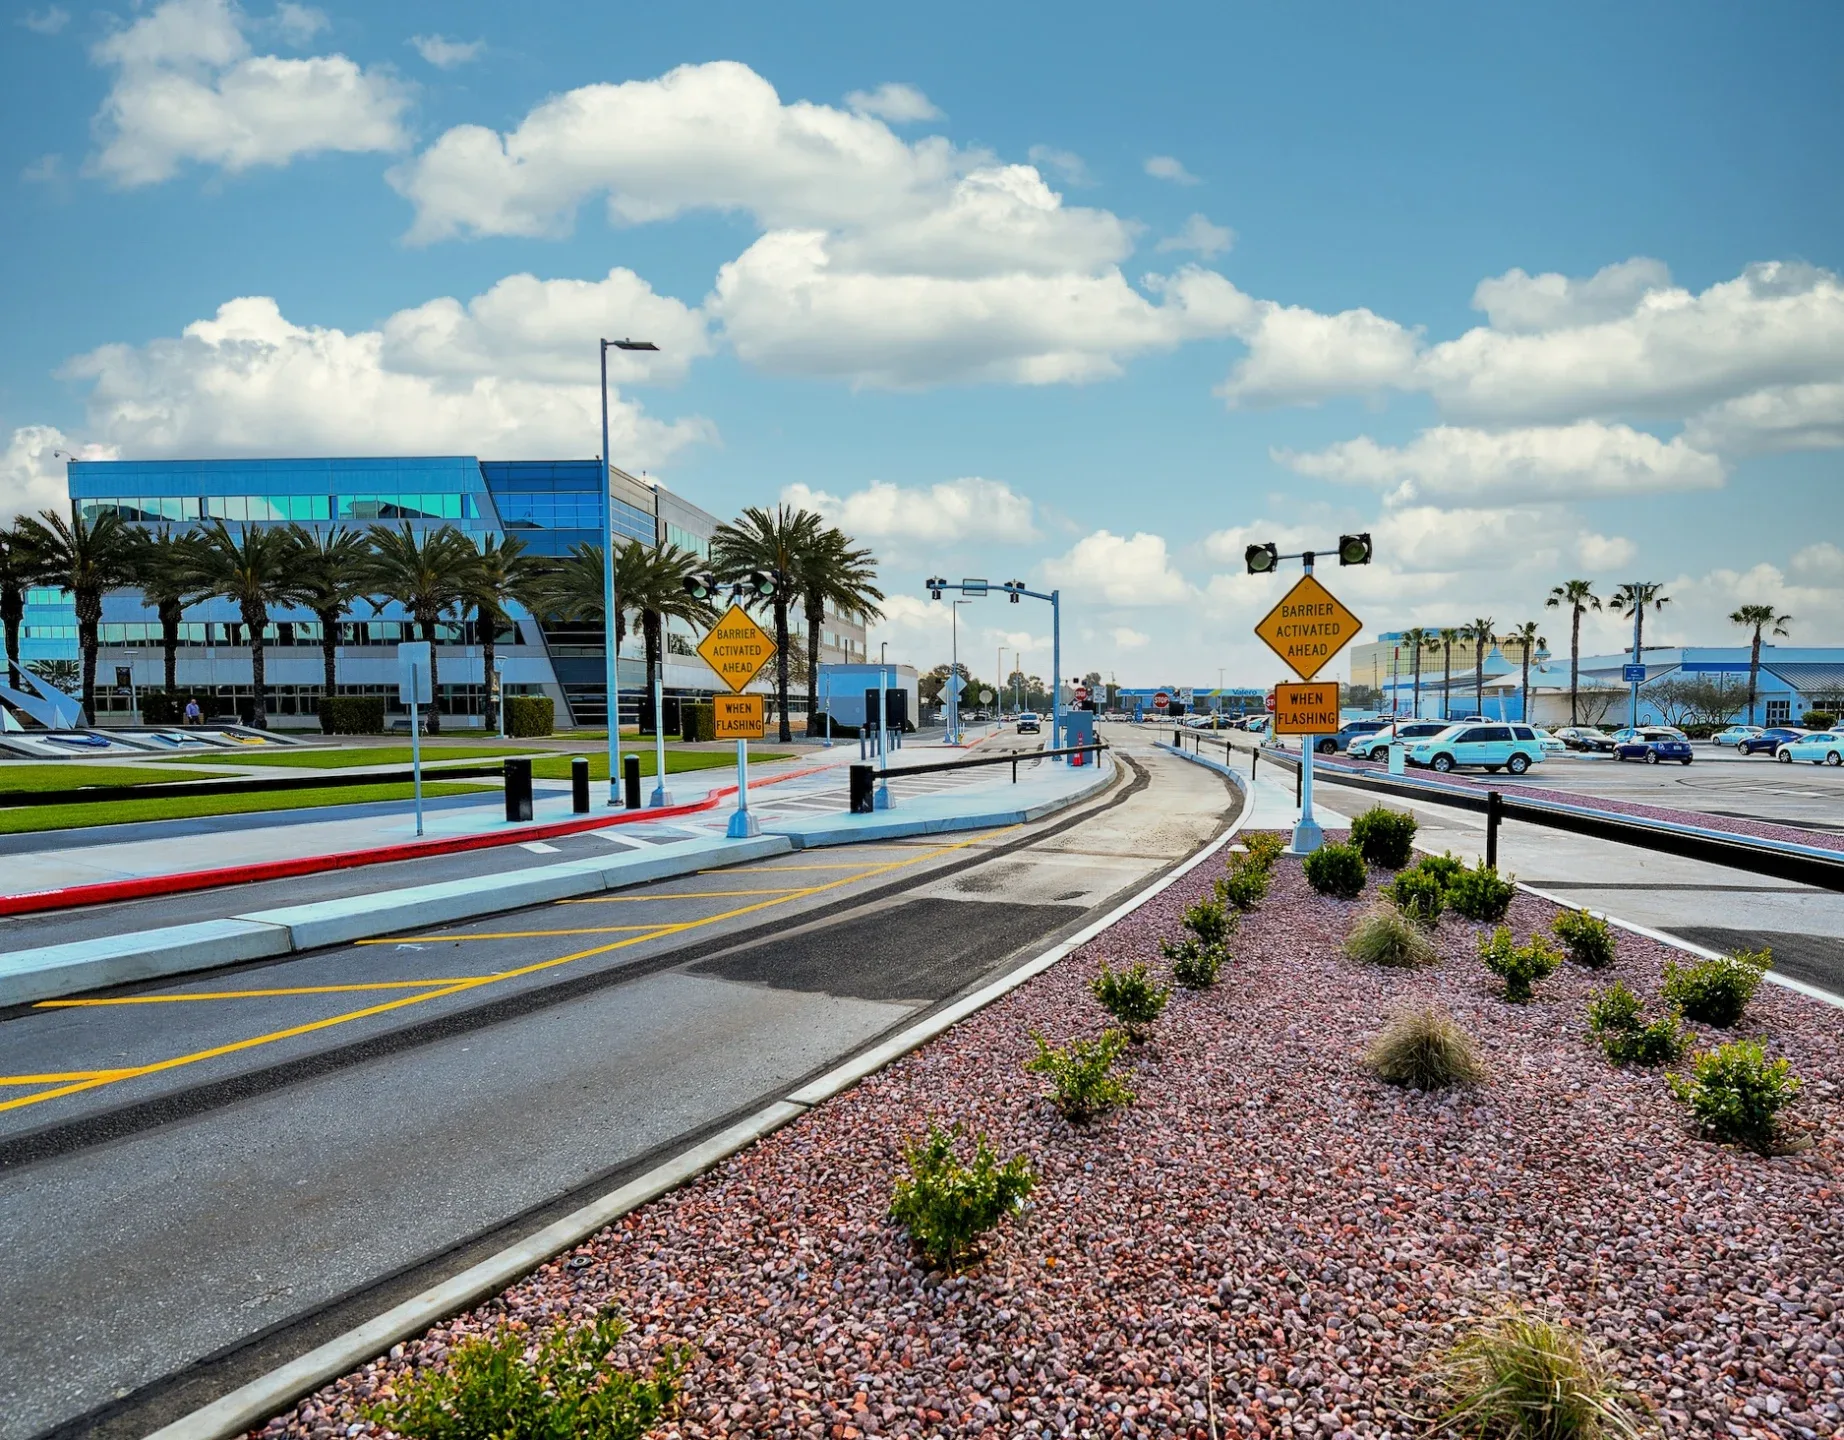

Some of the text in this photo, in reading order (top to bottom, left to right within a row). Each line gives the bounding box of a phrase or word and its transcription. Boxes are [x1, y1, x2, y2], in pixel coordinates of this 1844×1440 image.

[1282, 603, 1333, 617] BARRIER
[717, 628, 756, 639] BARRIER
[1276, 623, 1340, 637] ACTIVATED
[713, 645, 761, 656] ACTIVATED
[1287, 644, 1328, 656] AHEAD
[722, 662, 752, 673] AHEAD
[1290, 692, 1323, 704] WHEN
[725, 703, 751, 713] WHEN
[1278, 712, 1335, 724] FLASHING
[716, 720, 761, 730] FLASHING
